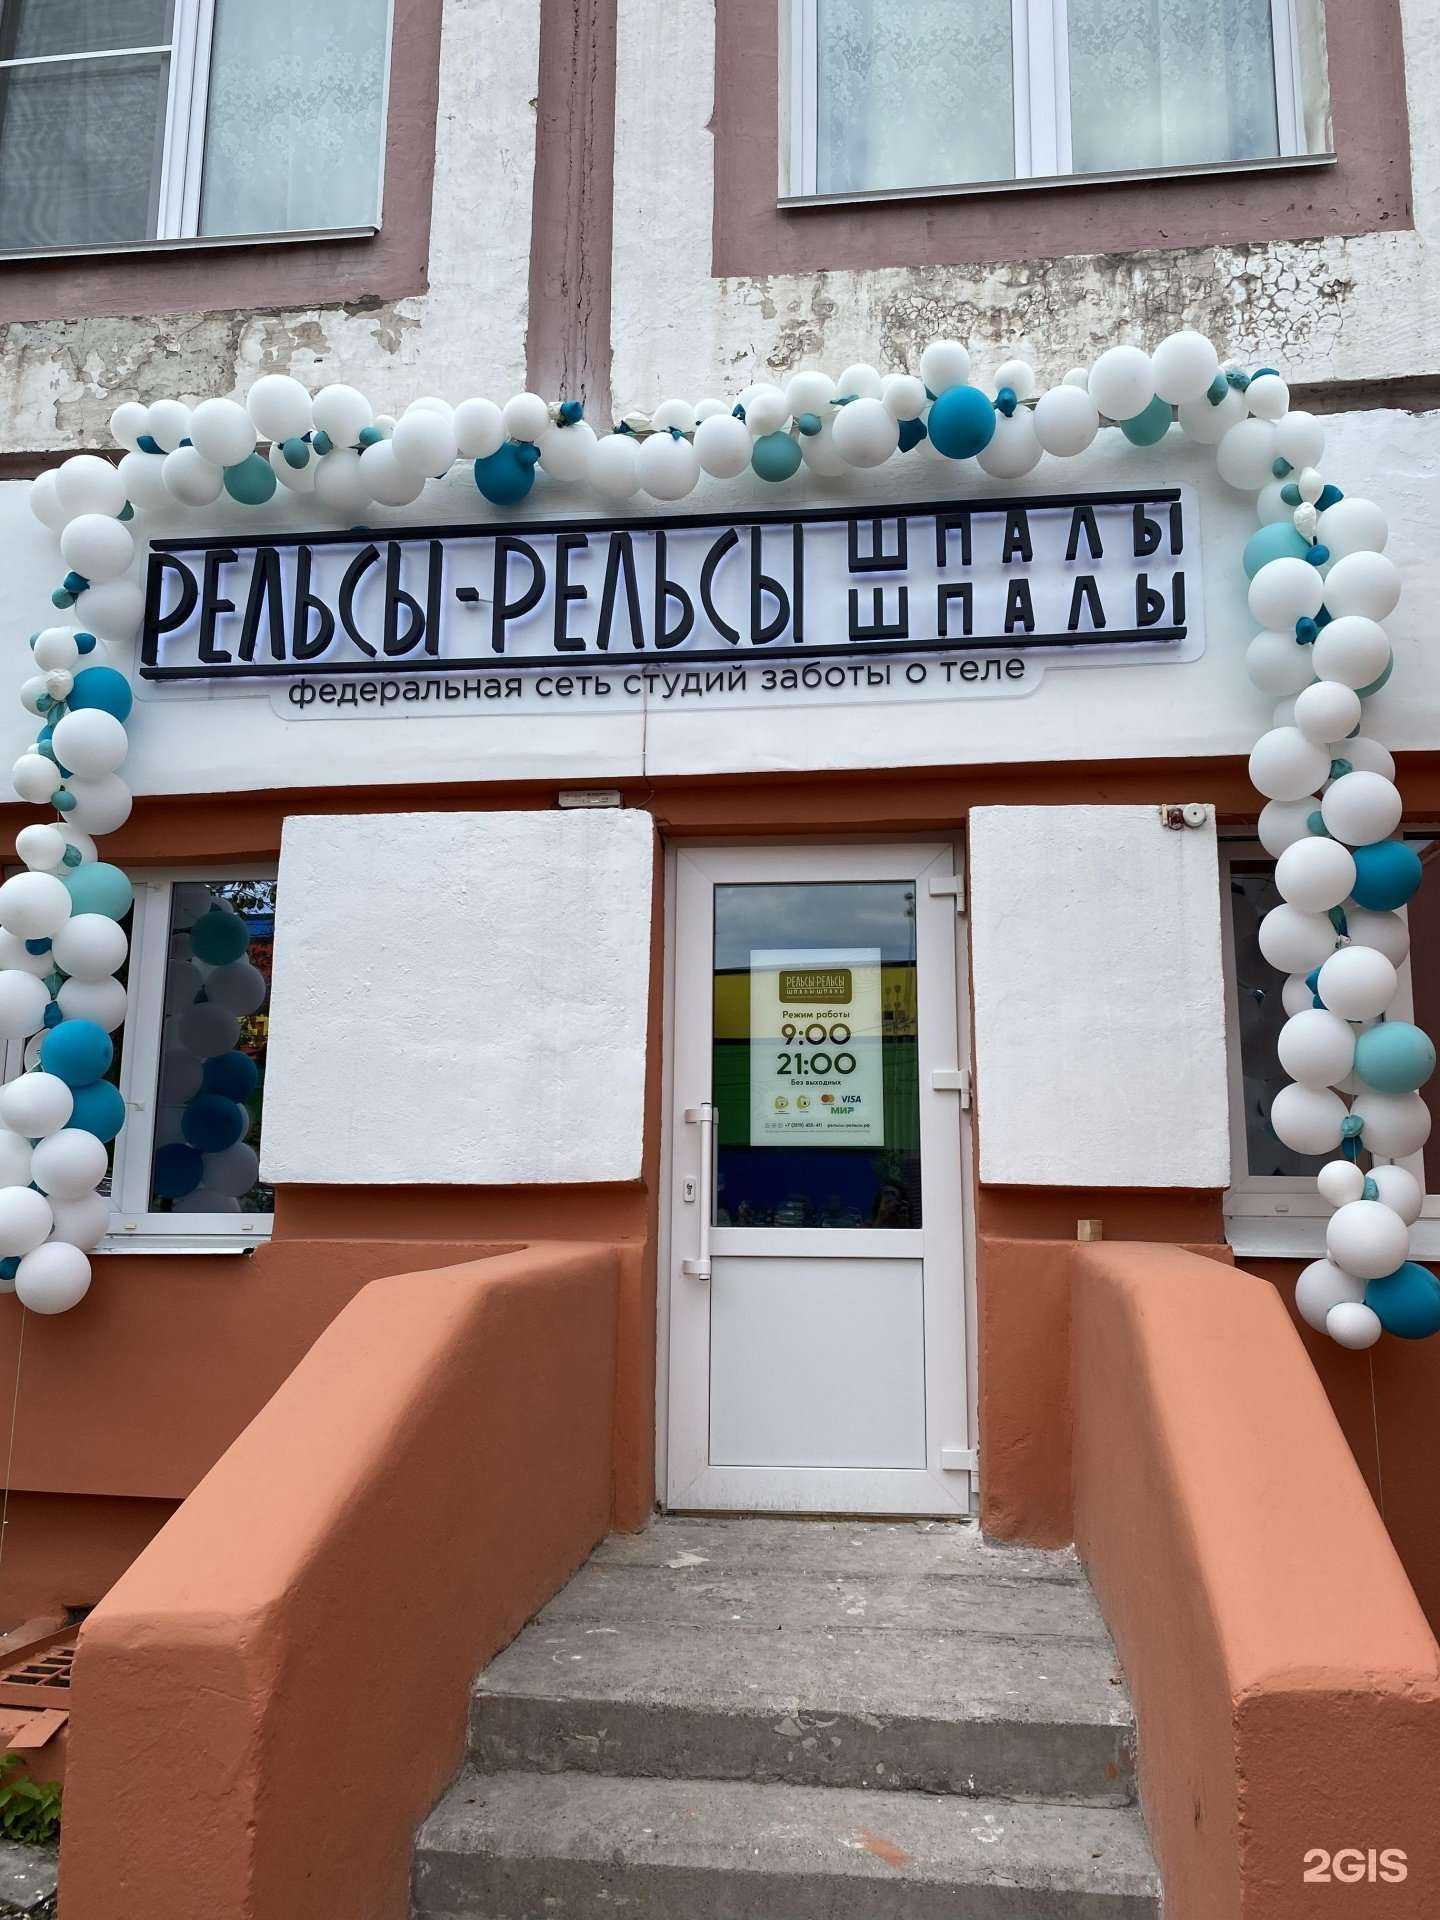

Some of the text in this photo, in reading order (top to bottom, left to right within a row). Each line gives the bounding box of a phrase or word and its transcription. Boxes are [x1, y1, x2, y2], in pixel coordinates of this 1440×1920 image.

[848, 502, 1183, 574] ШПАЛЫ
[141, 523, 804, 666] РЕЛЬСЫ-РЕЛЬСЫ
[848, 571, 1186, 642] ШПАЛЫ
[288, 656, 1026, 708] федеральная сеть студий заботы о теле
[782, 1010, 850, 1020] Режим работы
[781, 1023, 851, 1045] 9:00
[776, 1052, 857, 1075] 21:00
[841, 1095, 862, 1103] VISA
[830, 1107, 855, 1115] МИР
